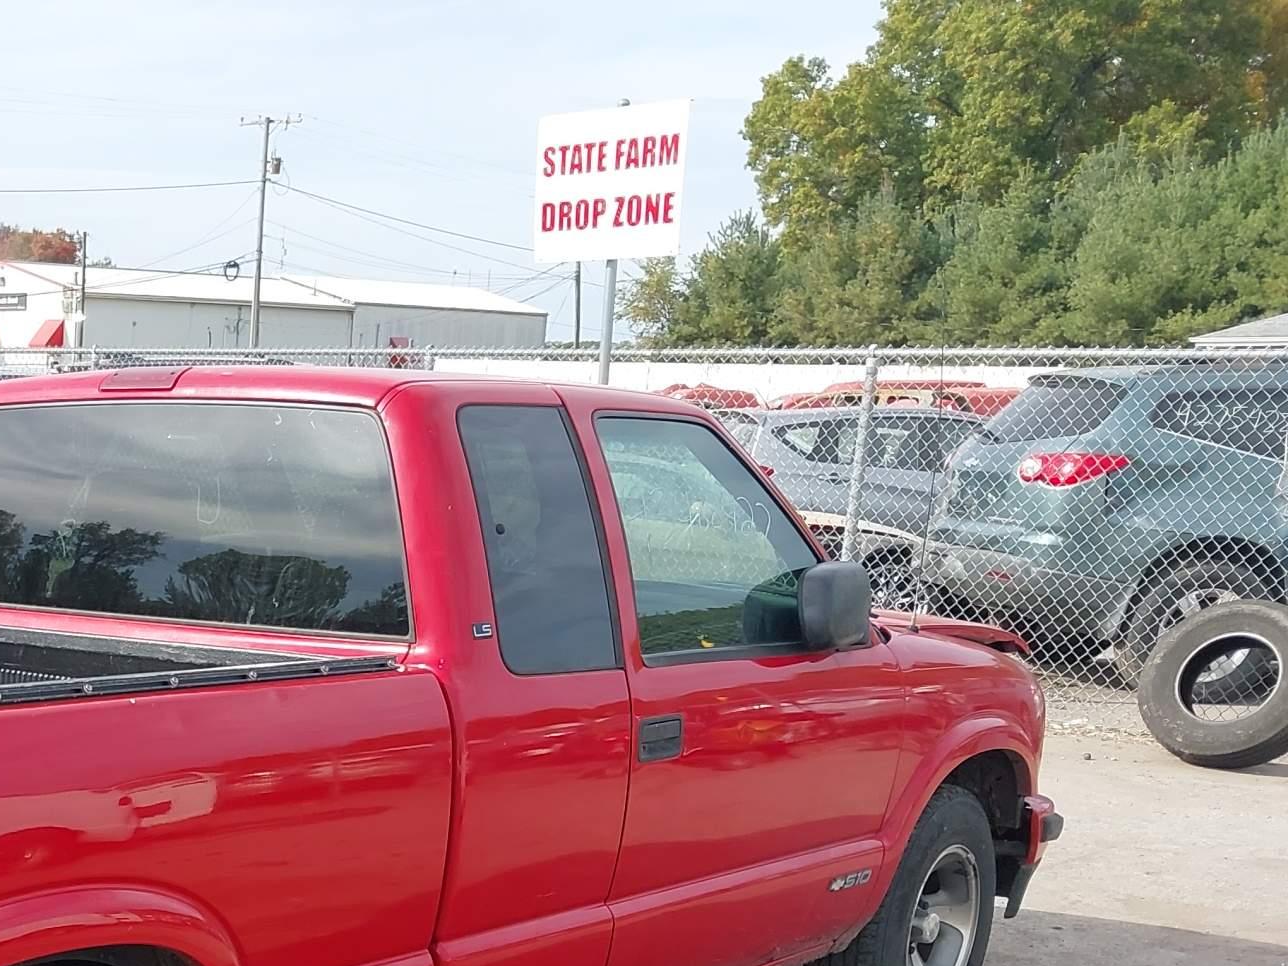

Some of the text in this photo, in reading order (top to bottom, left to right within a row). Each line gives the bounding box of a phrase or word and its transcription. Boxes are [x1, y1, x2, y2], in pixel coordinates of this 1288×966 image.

[543, 133, 680, 177] STATE FARM
[541, 192, 675, 232] DROP ZONE
[473, 624, 492, 637] LS
[844, 869, 872, 889] S10
